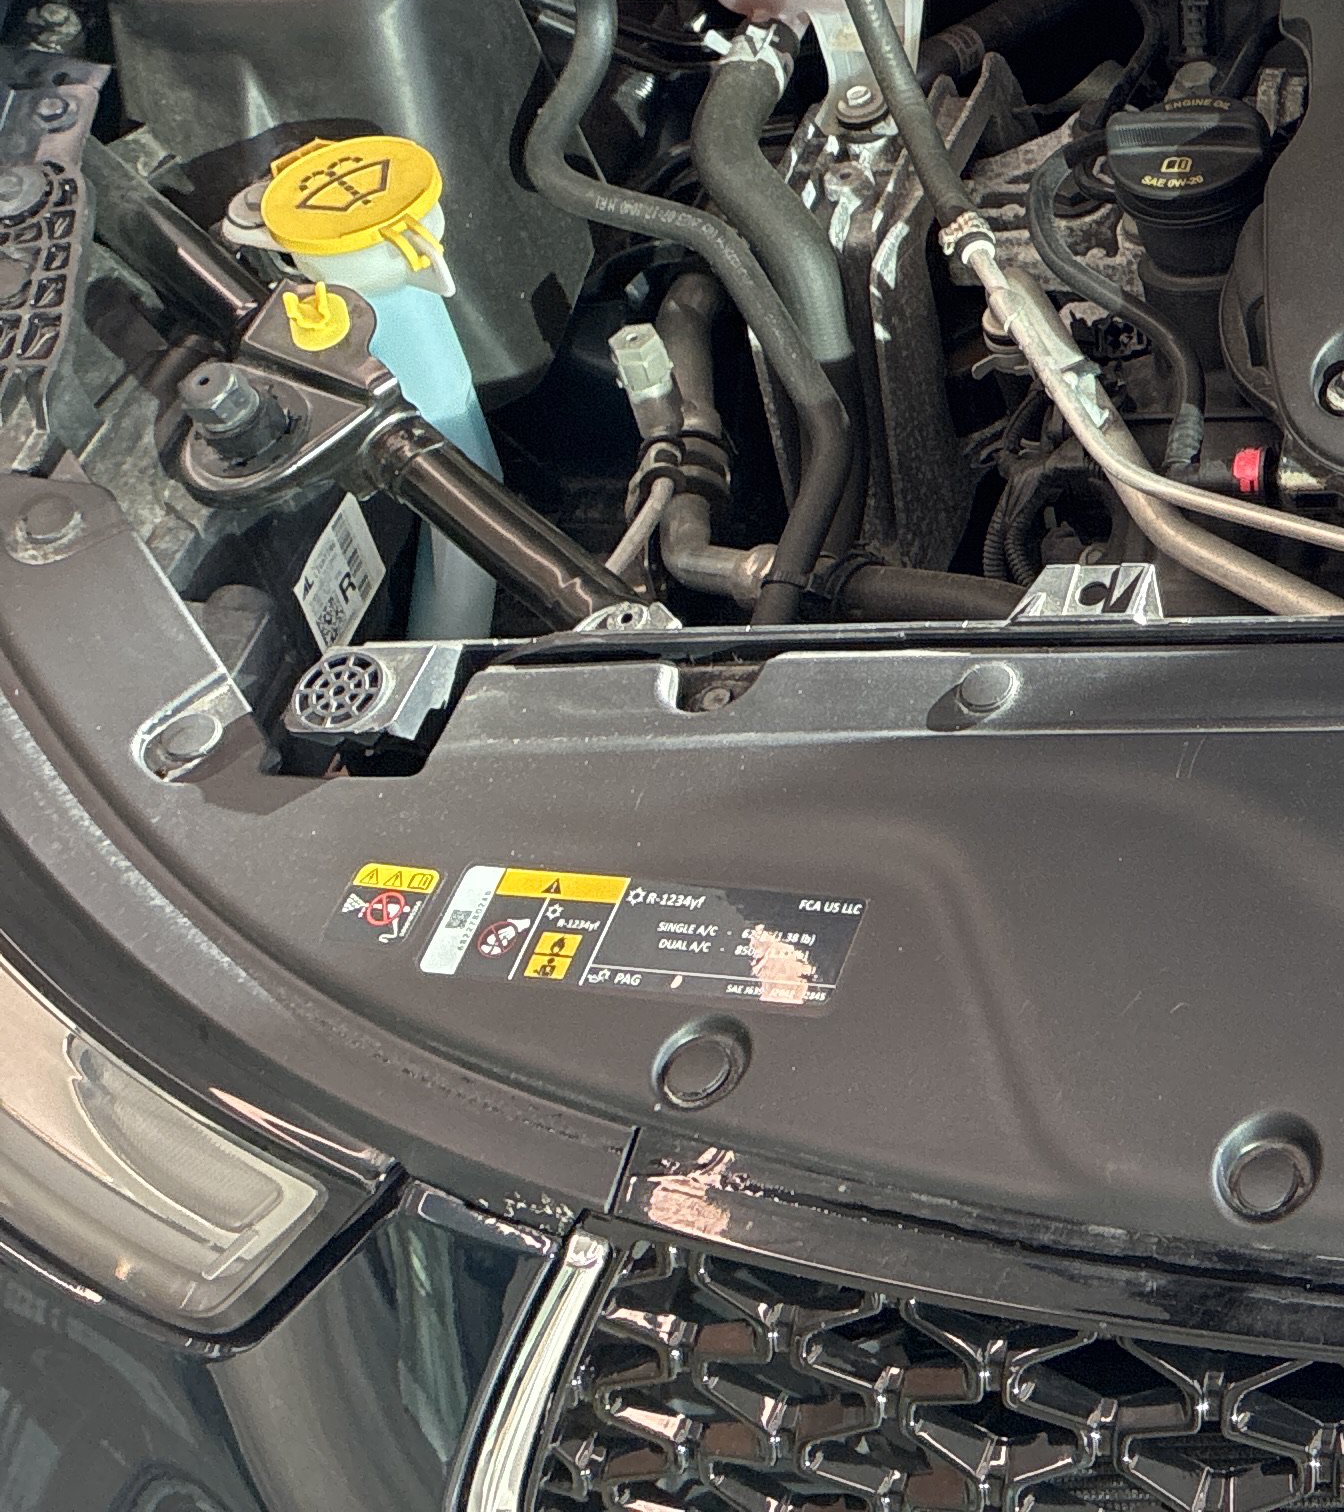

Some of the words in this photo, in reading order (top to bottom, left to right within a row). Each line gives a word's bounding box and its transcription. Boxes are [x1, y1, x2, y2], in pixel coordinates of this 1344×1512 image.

[1164, 98, 1212, 111] ENGINE
[1141, 175, 1166, 187] SAE
[1167, 175, 1205, 189] 0W-20
[340, 571, 357, 605] R
[646, 892, 706, 911] R-1234yf
[798, 899, 821, 912] FCA
[823, 901, 841, 913] US
[841, 903, 863, 915] LLC
[556, 919, 601, 932] R-1234yf
[656, 921, 697, 936] SINGLE
[697, 923, 719, 937] A/C
[658, 939, 689, 952] DUAL
[689, 940, 711, 954] A/C
[613, 973, 642, 987] PAG
[725, 983, 743, 994] SAE
